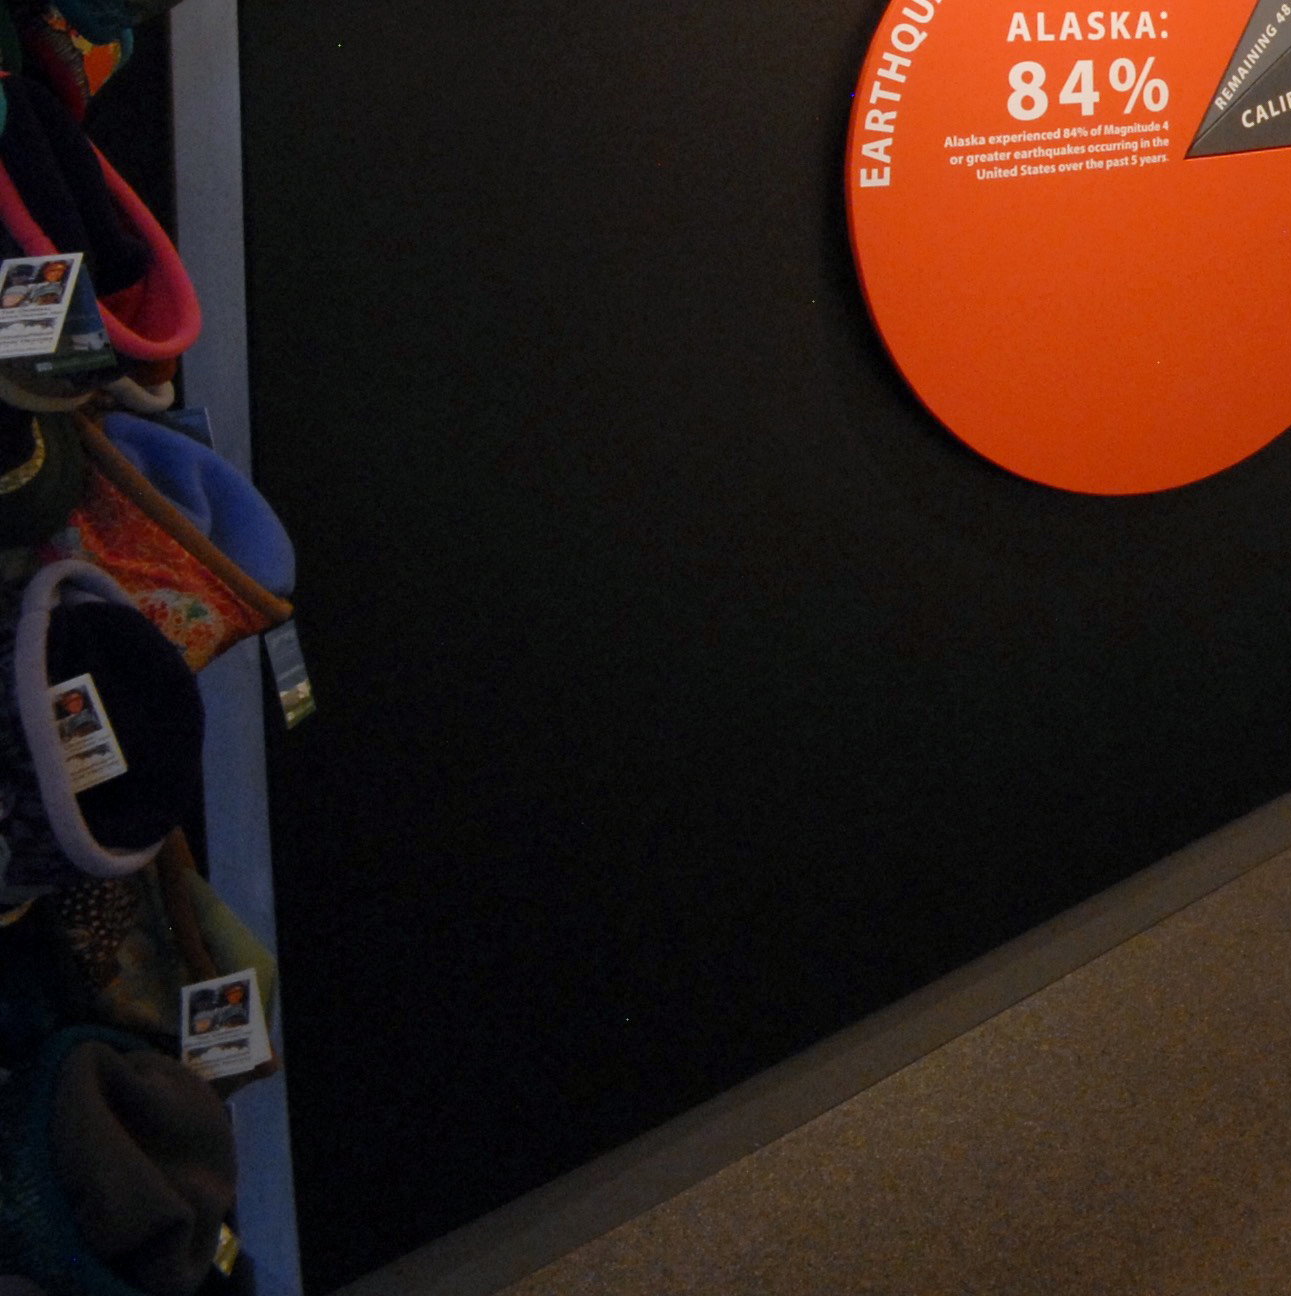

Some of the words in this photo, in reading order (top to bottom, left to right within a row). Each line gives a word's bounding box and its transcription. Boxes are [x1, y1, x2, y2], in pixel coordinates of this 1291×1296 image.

[1006, 10, 1169, 43] ALASKA:
[1214, 23, 1278, 110] REMAINING
[1275, 4, 1291, 25] 48
[1005, 56, 1170, 122] 84%
[944, 134, 986, 147] Alaska
[989, 128, 1061, 146] experienced
[1063, 127, 1088, 138] 84%
[1090, 125, 1102, 136] of
[1104, 122, 1160, 136] Magnitude
[1162, 121, 1169, 130] 4
[949, 156, 964, 165] or
[966, 152, 1011, 166] greater
[1014, 144, 1086, 160] earthquakes
[1087, 140, 1138, 152] occurring
[1140, 138, 1150, 148] in
[1152, 137, 1169, 147] the
[976, 166, 1018, 180] United
[1021, 164, 1056, 175] States
[1058, 162, 1084, 172] over
[1085, 159, 1104, 169] the
[1106, 156, 1129, 170] past
[1131, 155, 1137, 165] 5
[1140, 154, 1168, 166] years.
